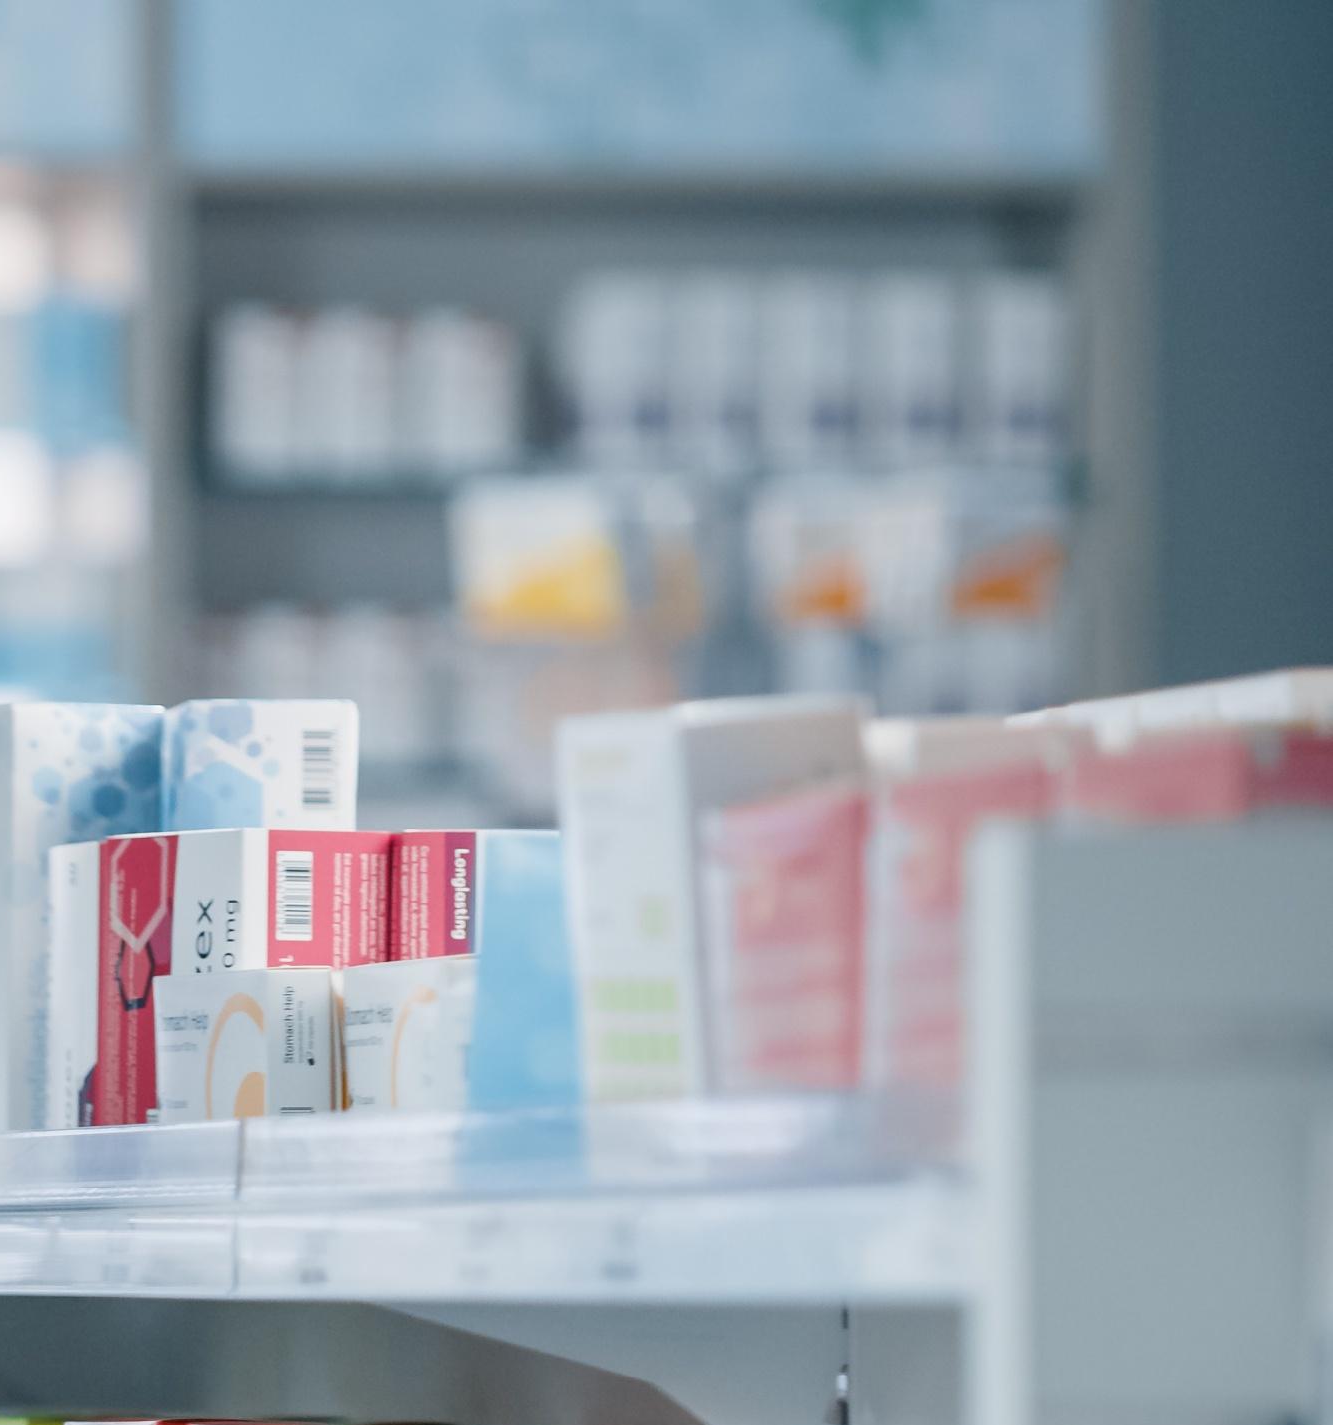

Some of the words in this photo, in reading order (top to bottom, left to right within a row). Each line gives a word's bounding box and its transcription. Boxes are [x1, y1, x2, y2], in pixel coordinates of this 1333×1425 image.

[450, 848, 471, 940] Longlasting
[194, 899, 213, 973] ex
[284, 986, 295, 1011] Help
[284, 1015, 295, 1064] Stomach
